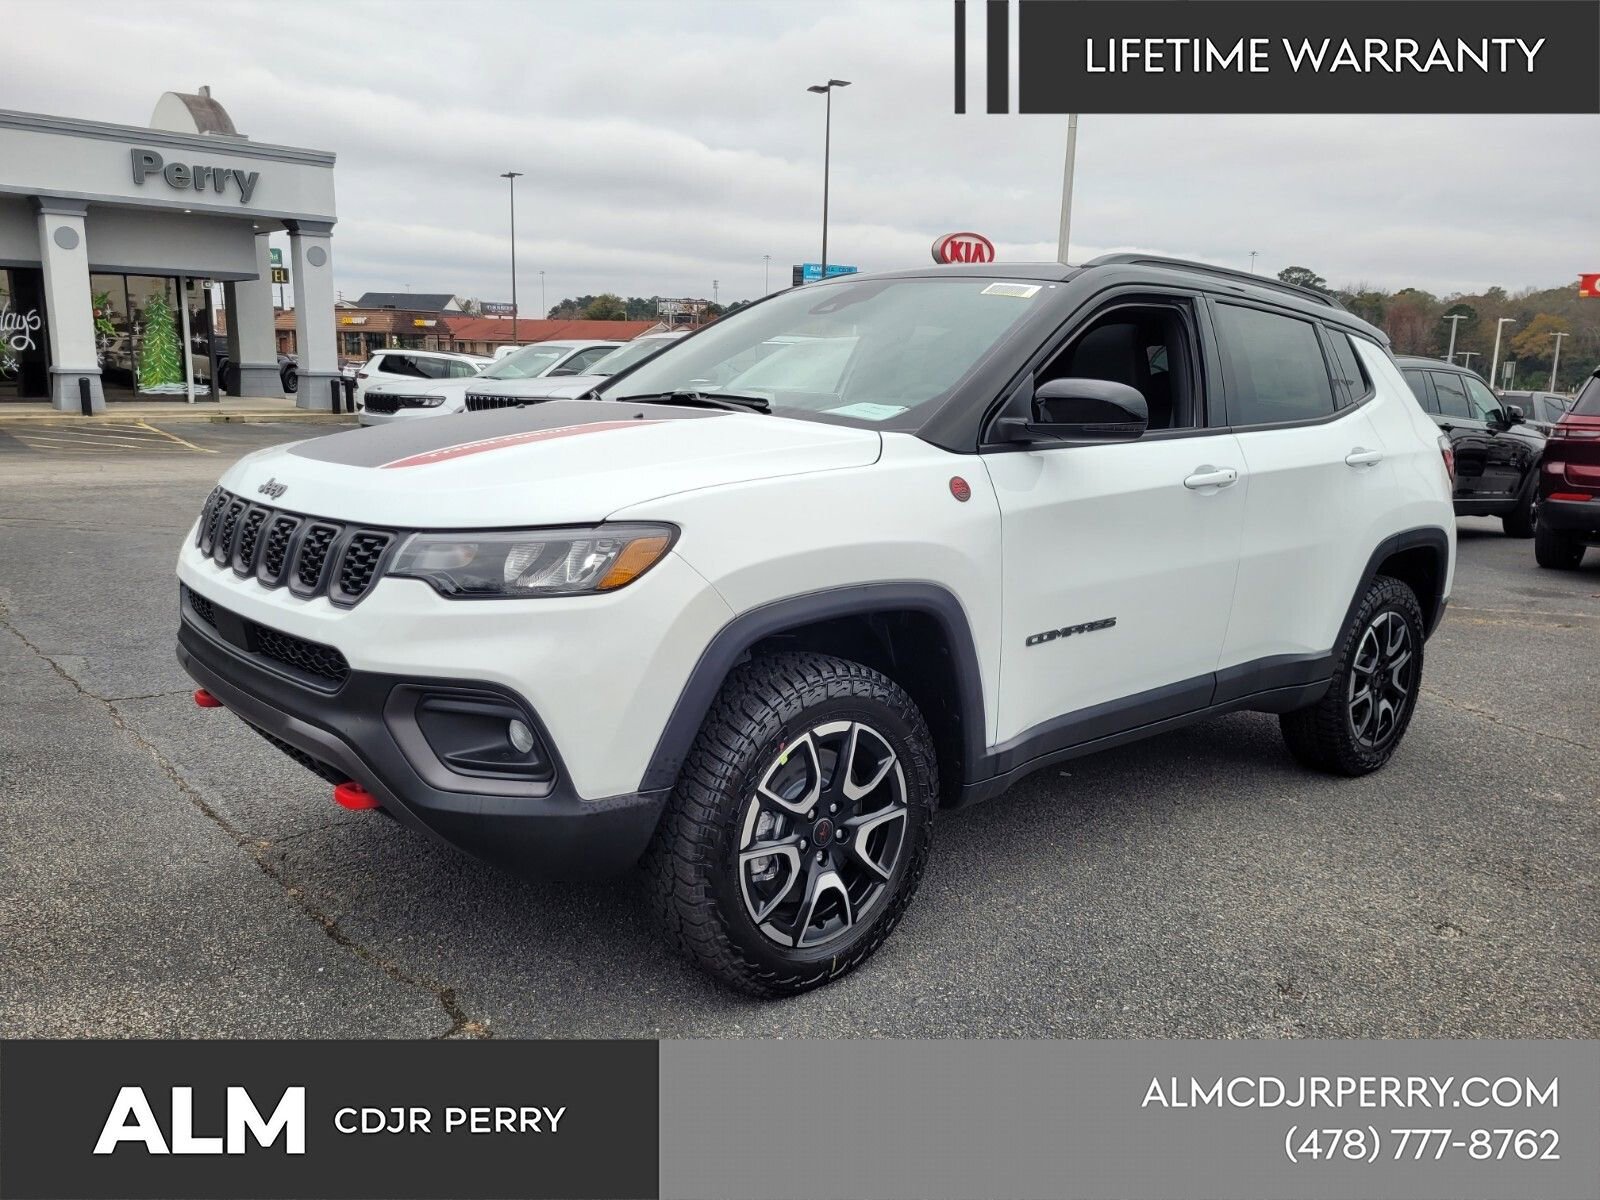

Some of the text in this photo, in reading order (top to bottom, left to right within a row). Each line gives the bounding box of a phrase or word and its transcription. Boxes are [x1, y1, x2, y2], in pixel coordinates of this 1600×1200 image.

[131, 148, 260, 203] Perry
[950, 240, 986, 263] KIA
[272, 269, 287, 282] EL
[342, 316, 367, 324] SUBWAY
[258, 477, 288, 500] Jeep
[1025, 616, 1117, 647] COMPASS
